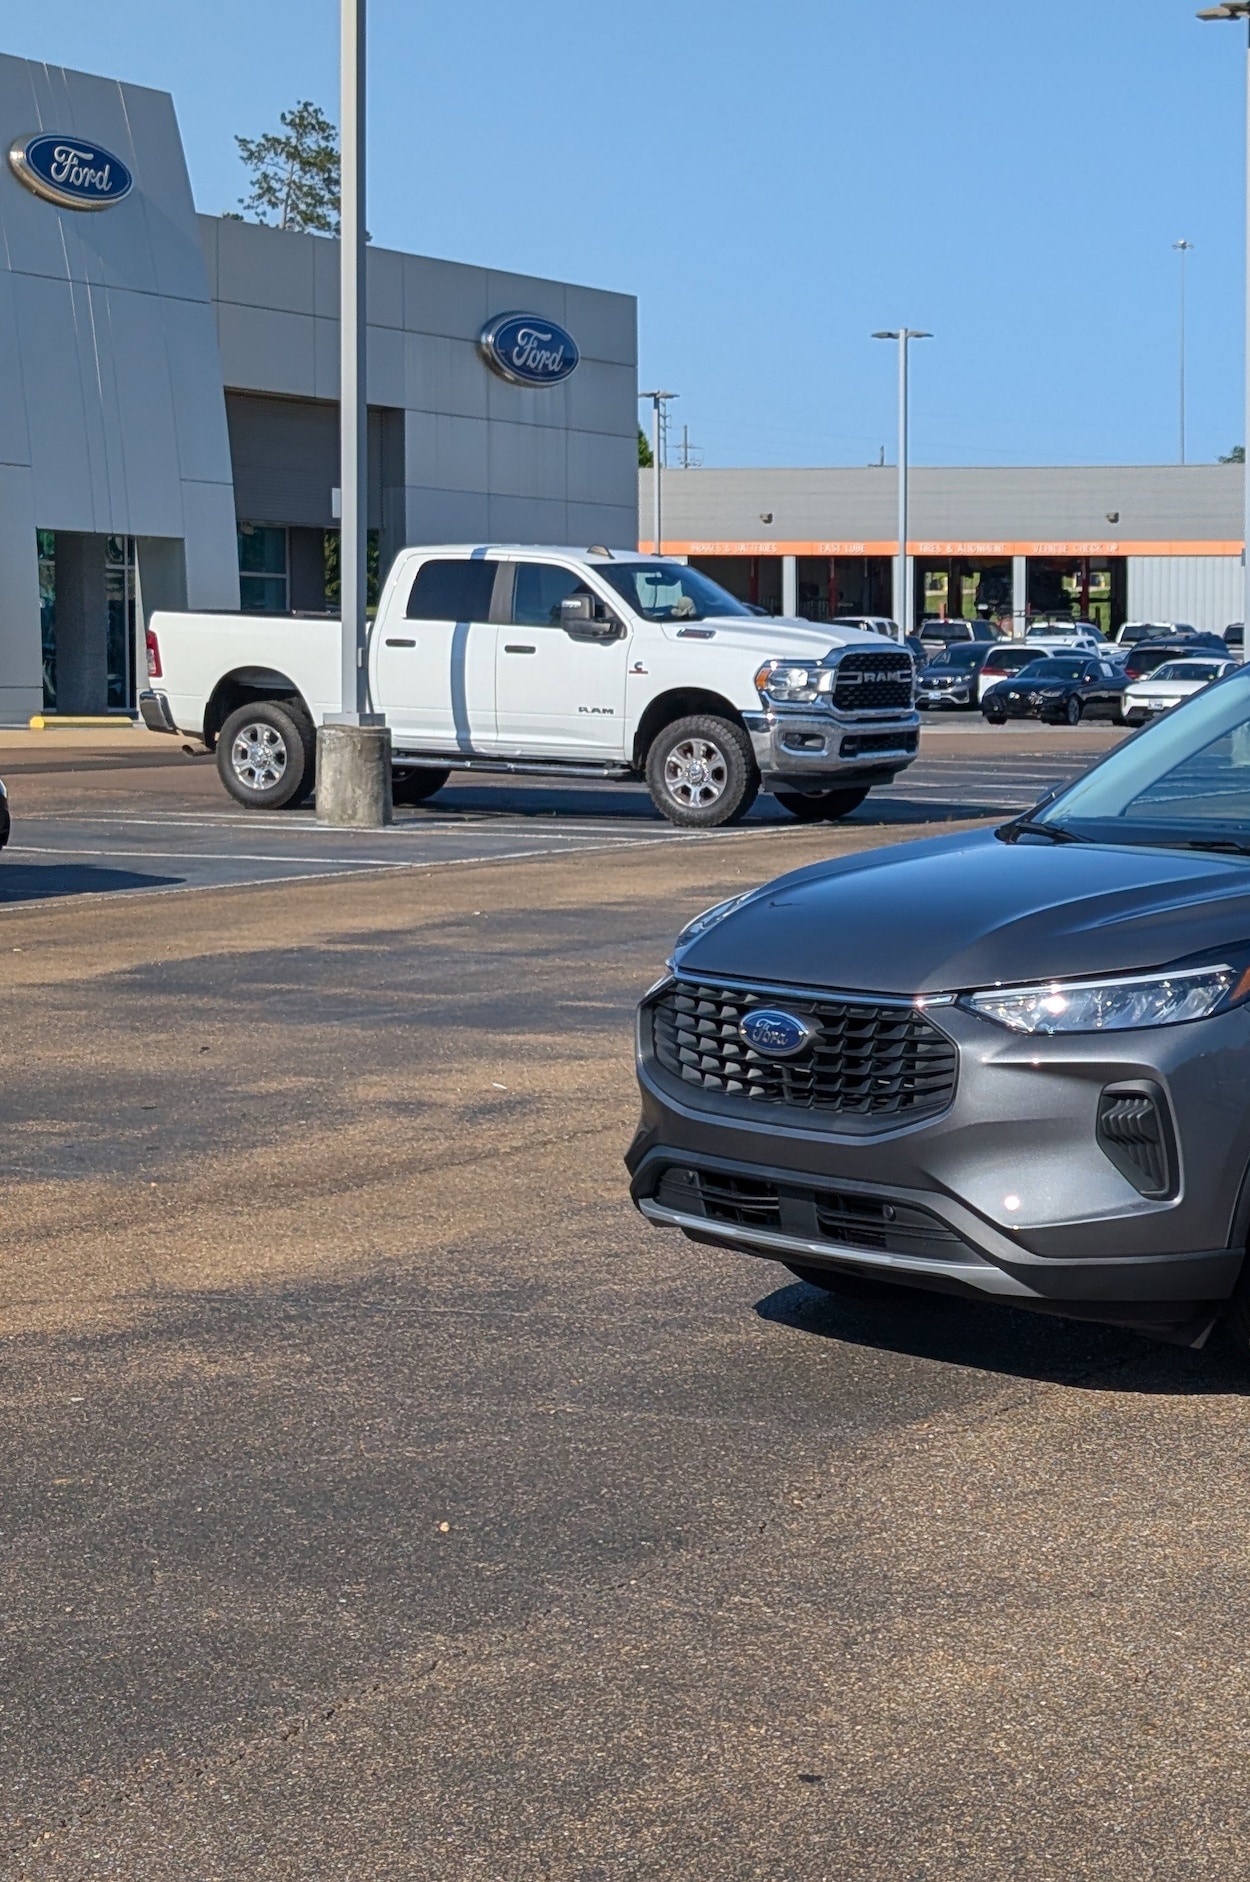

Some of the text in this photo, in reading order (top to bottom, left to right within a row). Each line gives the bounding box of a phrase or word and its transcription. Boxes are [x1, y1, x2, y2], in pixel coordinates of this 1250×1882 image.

[50, 145, 113, 191] Ford
[512, 328, 565, 372] Ford
[819, 543, 866, 553] FAST LUBE
[918, 543, 942, 553] TIRES
[957, 543, 1007, 553] ALIGNMENT
[1033, 543, 1068, 553] VEHICLE
[1071, 543, 1103, 553] CHECK
[863, 671, 900, 682] RAM
[578, 706, 614, 714] RAM
[752, 1018, 789, 1045] Ford
